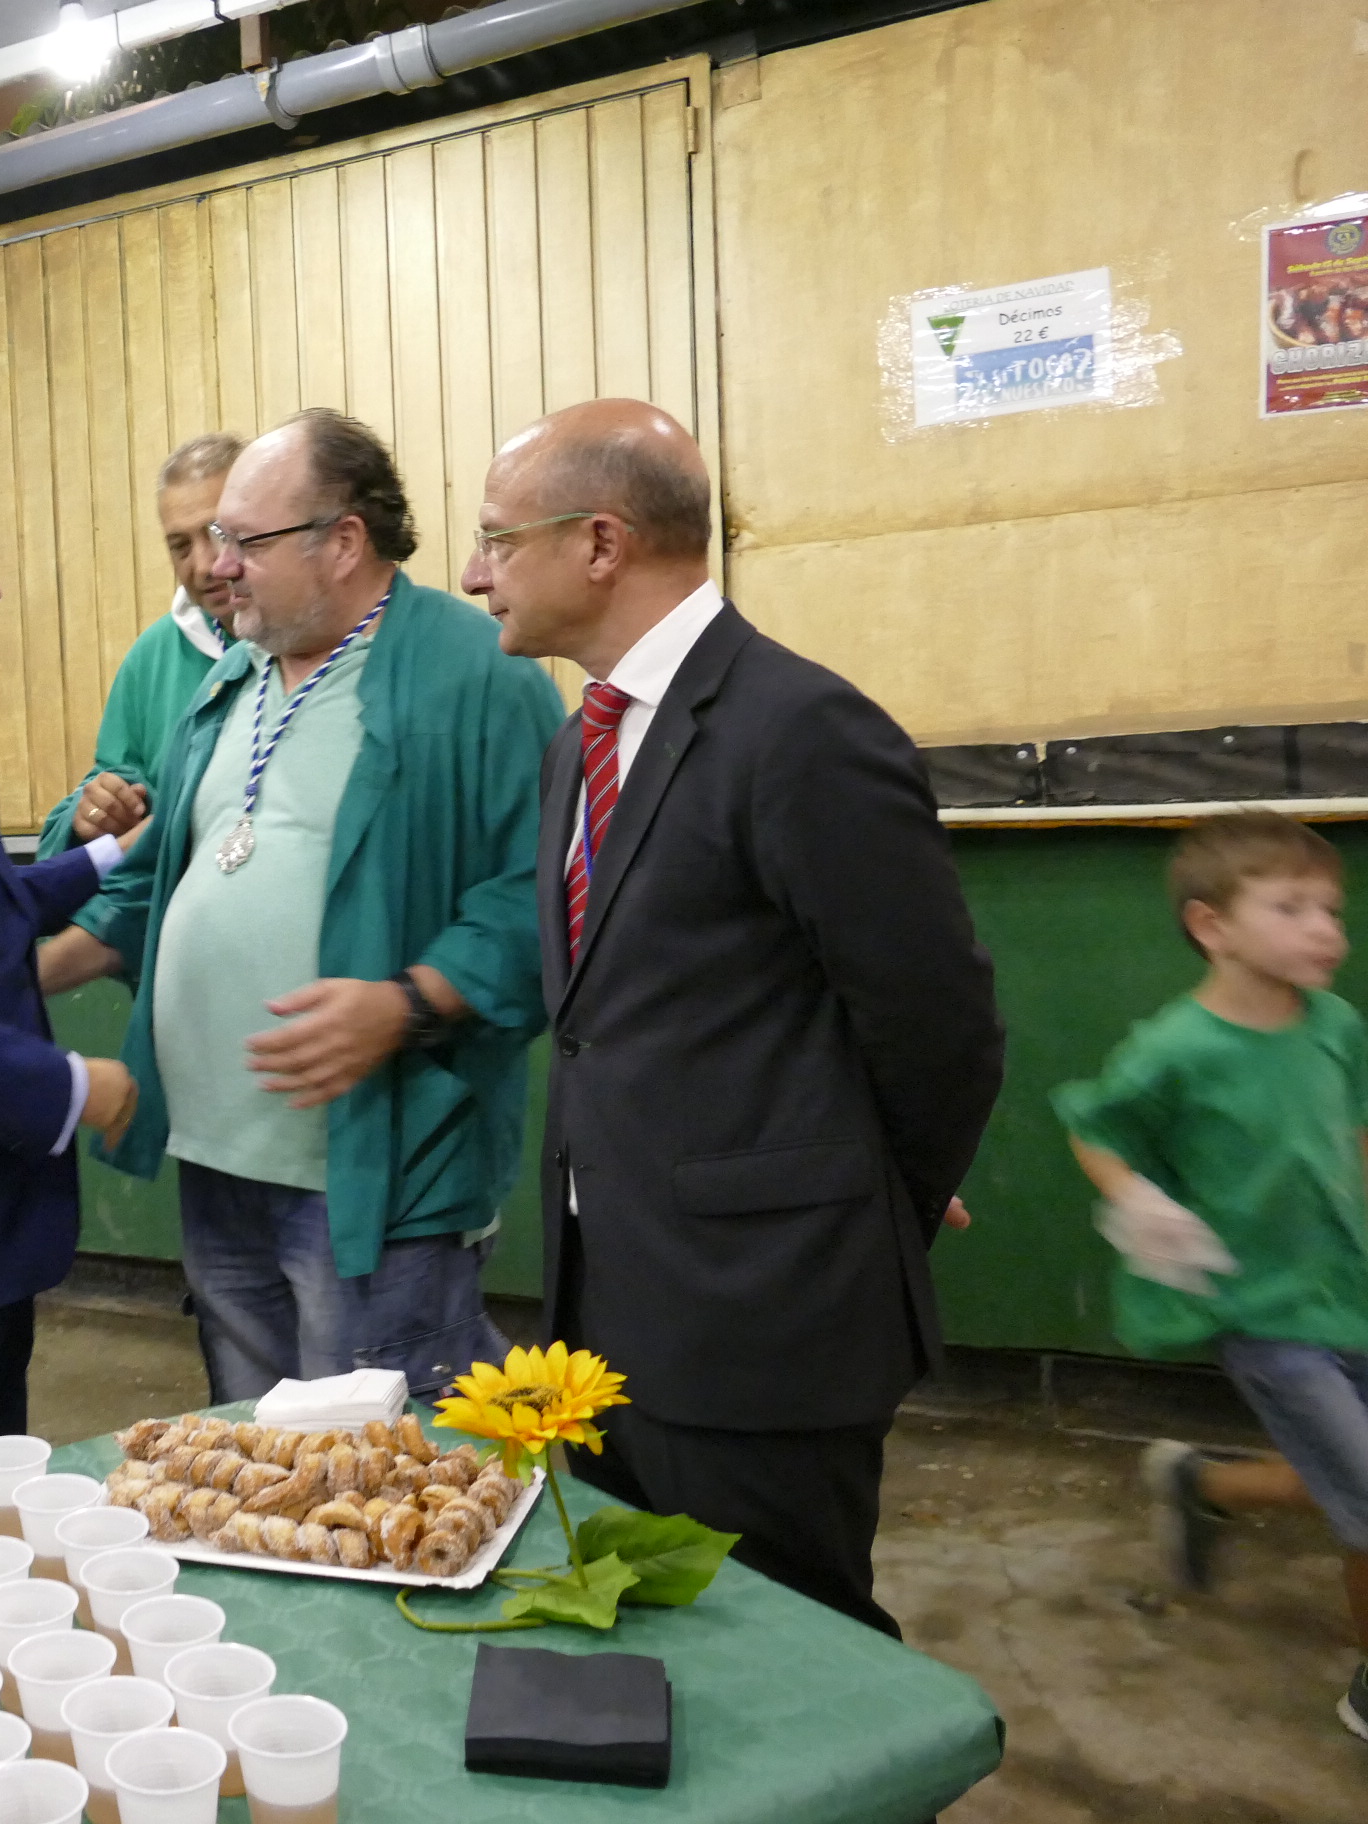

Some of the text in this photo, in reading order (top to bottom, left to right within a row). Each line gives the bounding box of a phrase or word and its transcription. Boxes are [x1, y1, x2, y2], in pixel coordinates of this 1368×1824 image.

[998, 305, 1063, 326] Décimos
[1013, 326, 1049, 343] 22 €
